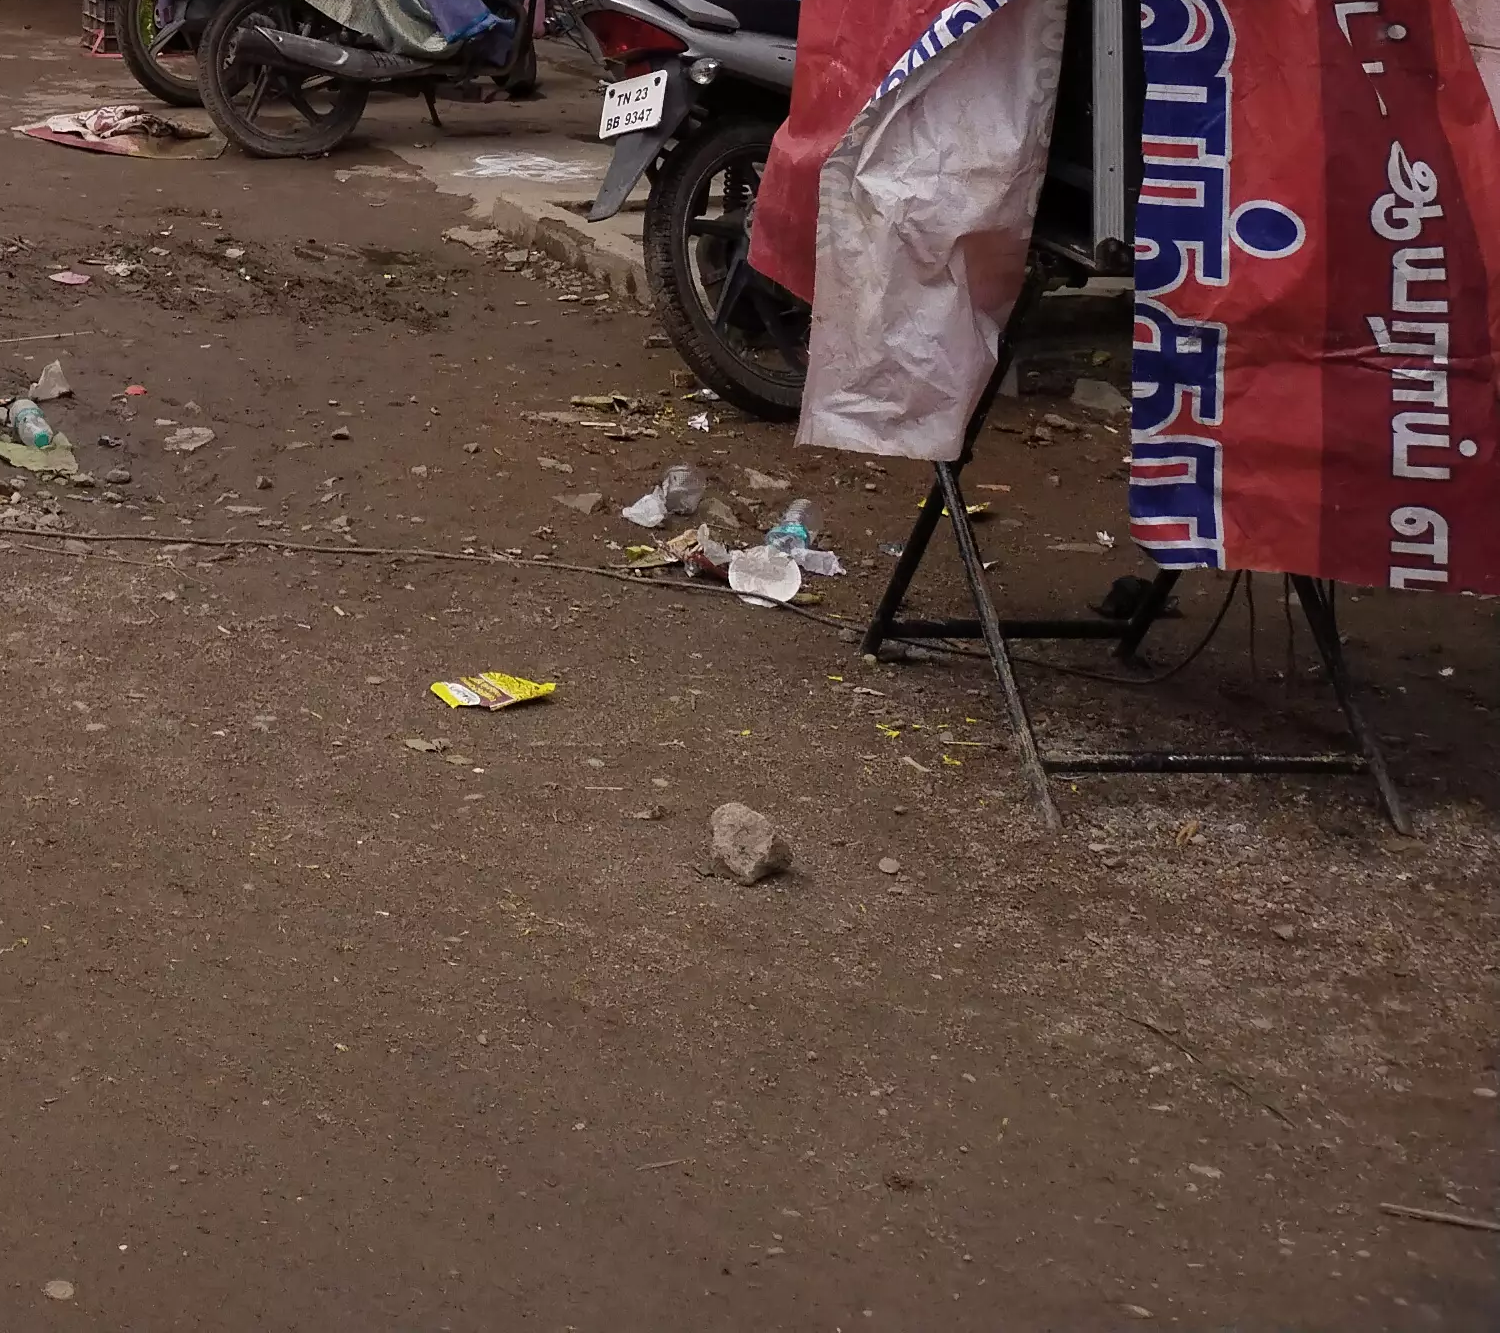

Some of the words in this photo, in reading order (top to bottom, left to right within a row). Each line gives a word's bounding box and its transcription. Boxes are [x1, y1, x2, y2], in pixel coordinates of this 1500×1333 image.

[617, 91, 632, 107] TN
[634, 87, 649, 102] 23
[605, 116, 620, 132] BB
[624, 108, 653, 126] 9347
